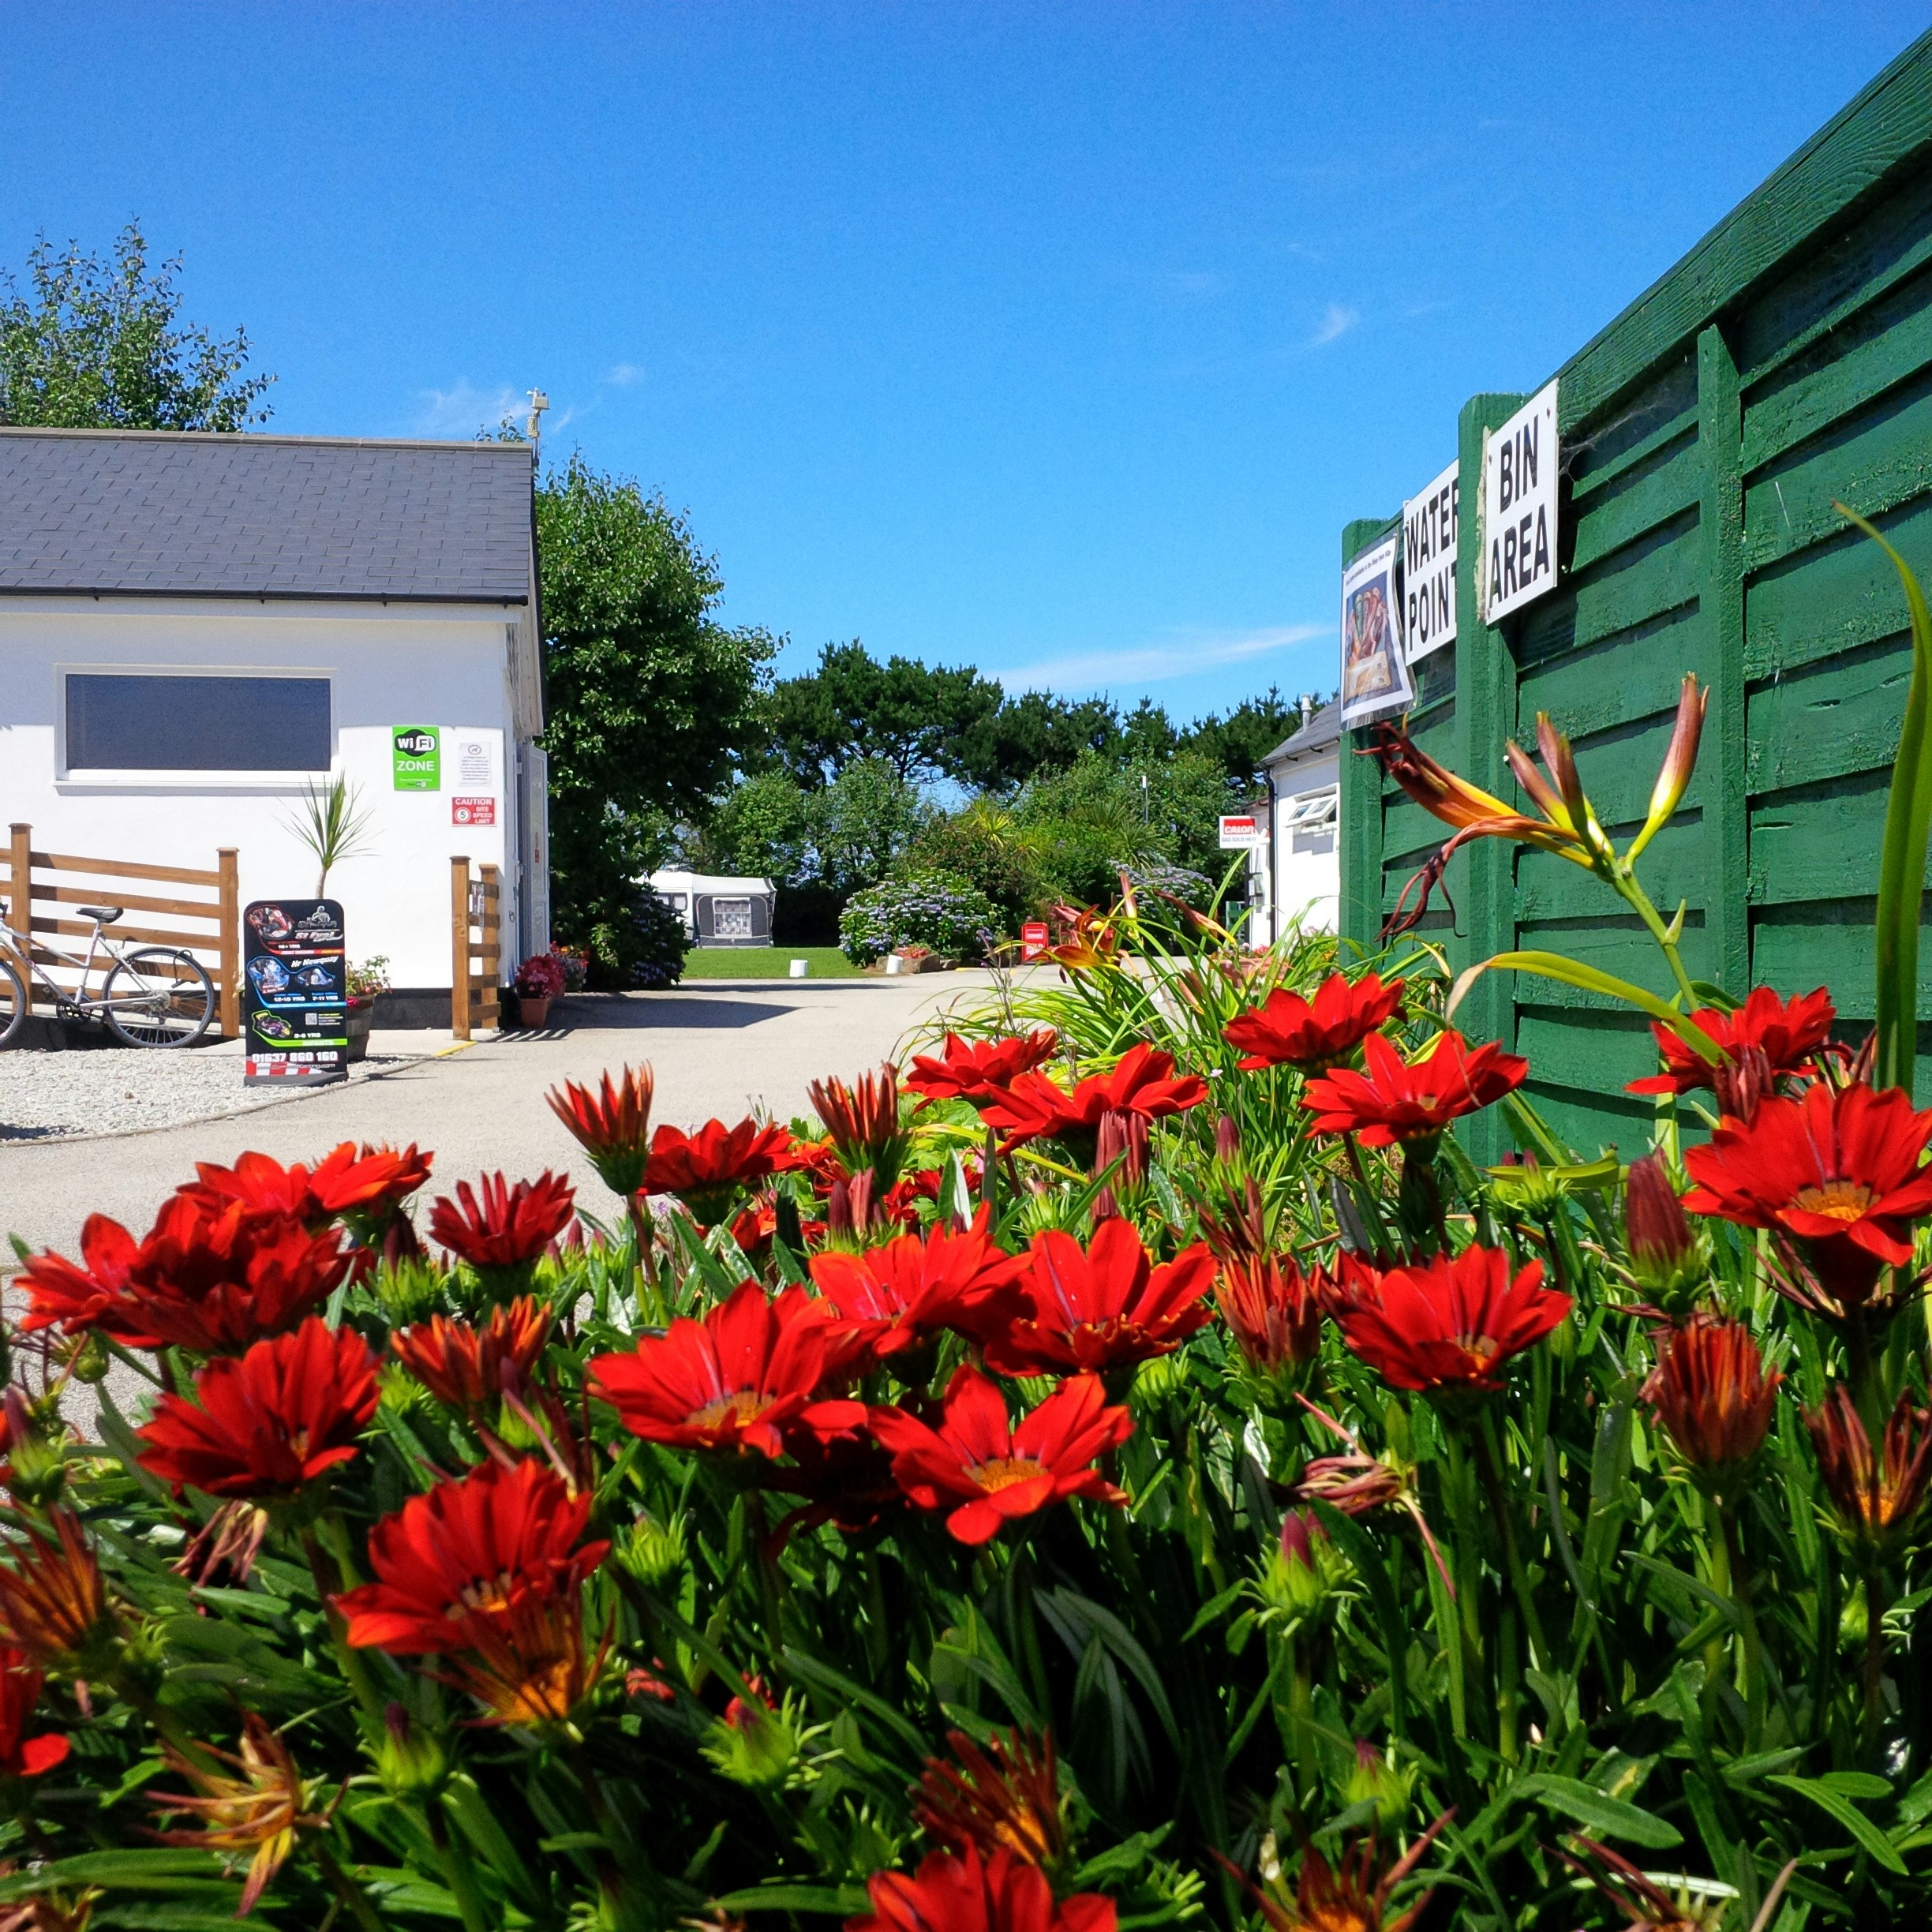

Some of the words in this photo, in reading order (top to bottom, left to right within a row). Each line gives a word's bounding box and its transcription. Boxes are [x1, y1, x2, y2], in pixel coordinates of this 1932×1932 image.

[1500, 414, 1538, 515] BIN
[1489, 503, 1549, 608] AREA
[397, 760, 434, 771] ZONE
[460, 811, 466, 819] 5
[252, 1053, 286, 1062] 01637
[316, 1050, 338, 1061] 160
